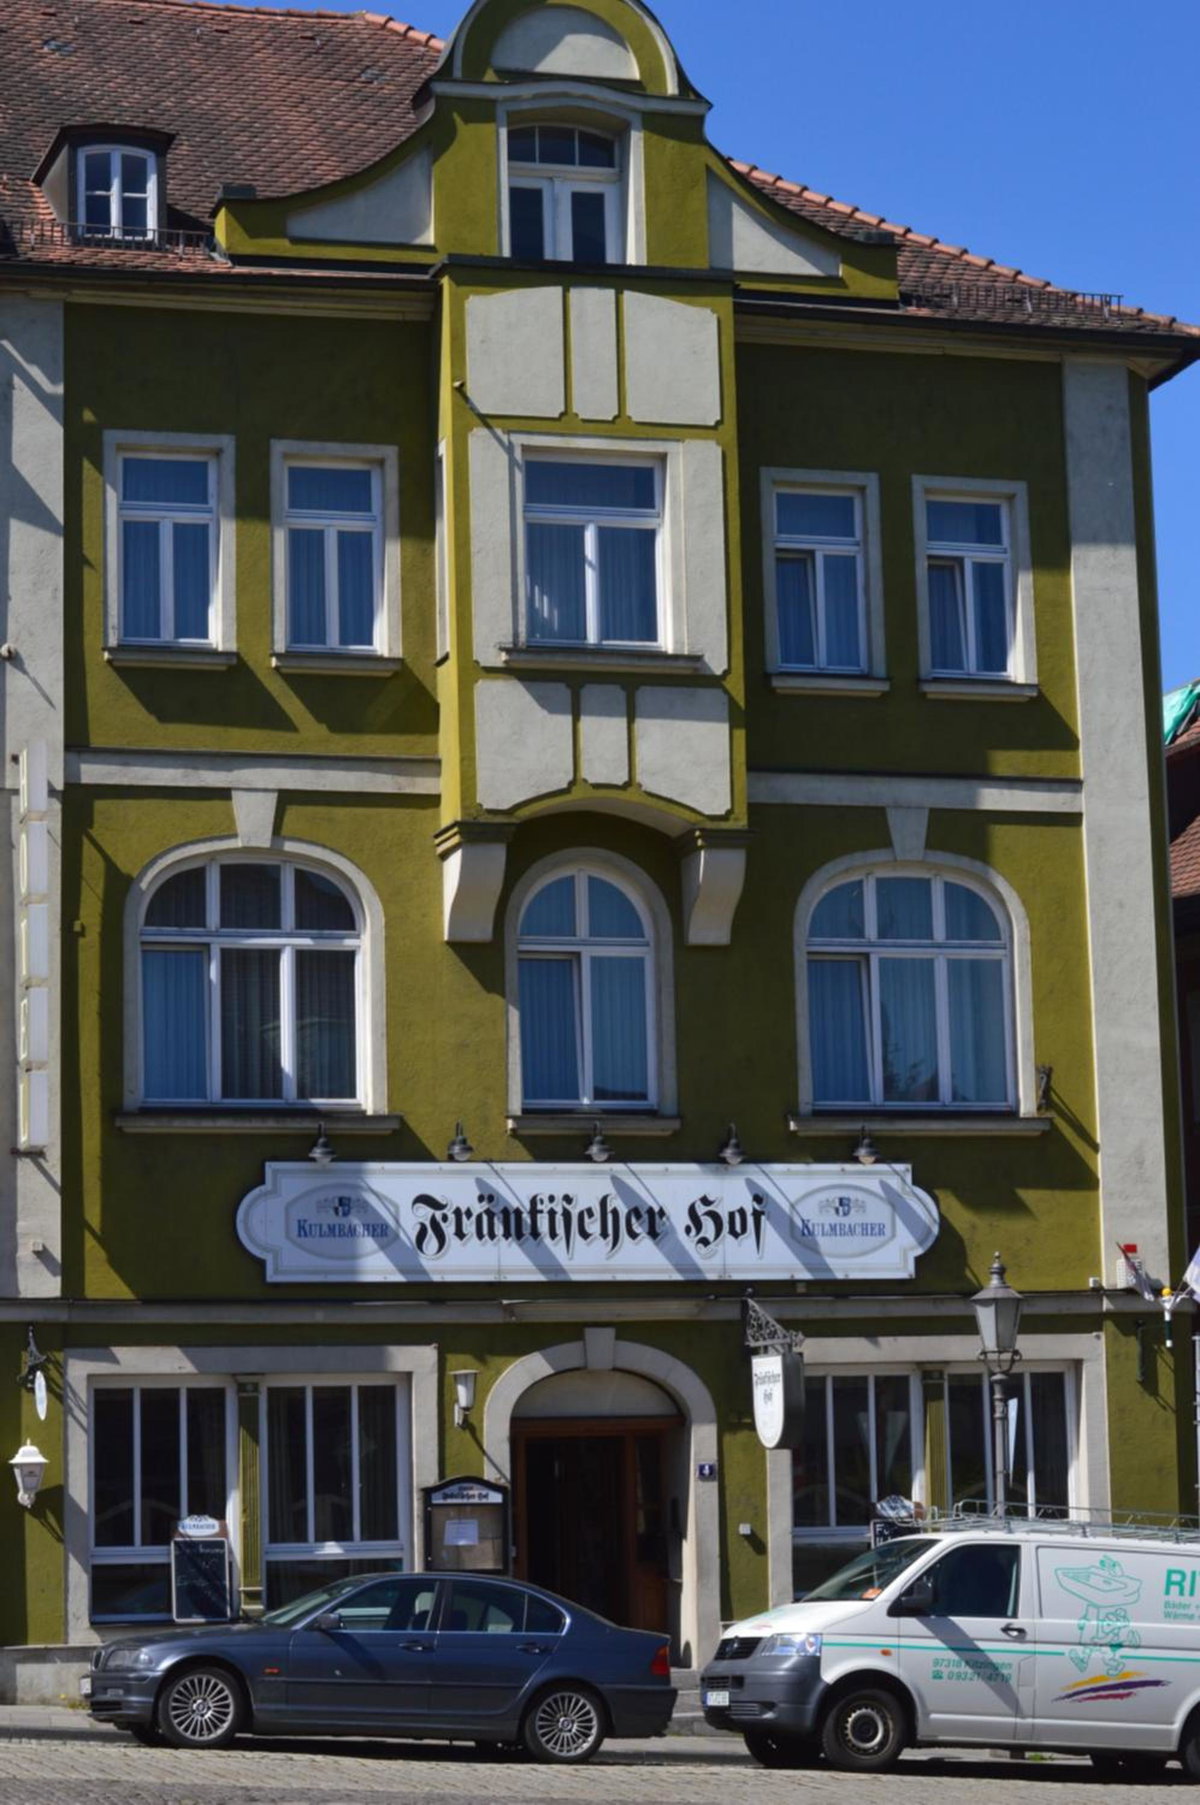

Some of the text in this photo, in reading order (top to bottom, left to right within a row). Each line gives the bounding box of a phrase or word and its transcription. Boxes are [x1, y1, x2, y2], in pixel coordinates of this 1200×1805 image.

[297, 1219, 389, 1239] KULMBACHER
[684, 1194, 766, 1258] Hof
[801, 1219, 887, 1238] KULMBACHER
[1164, 1568, 1200, 1597] RI
